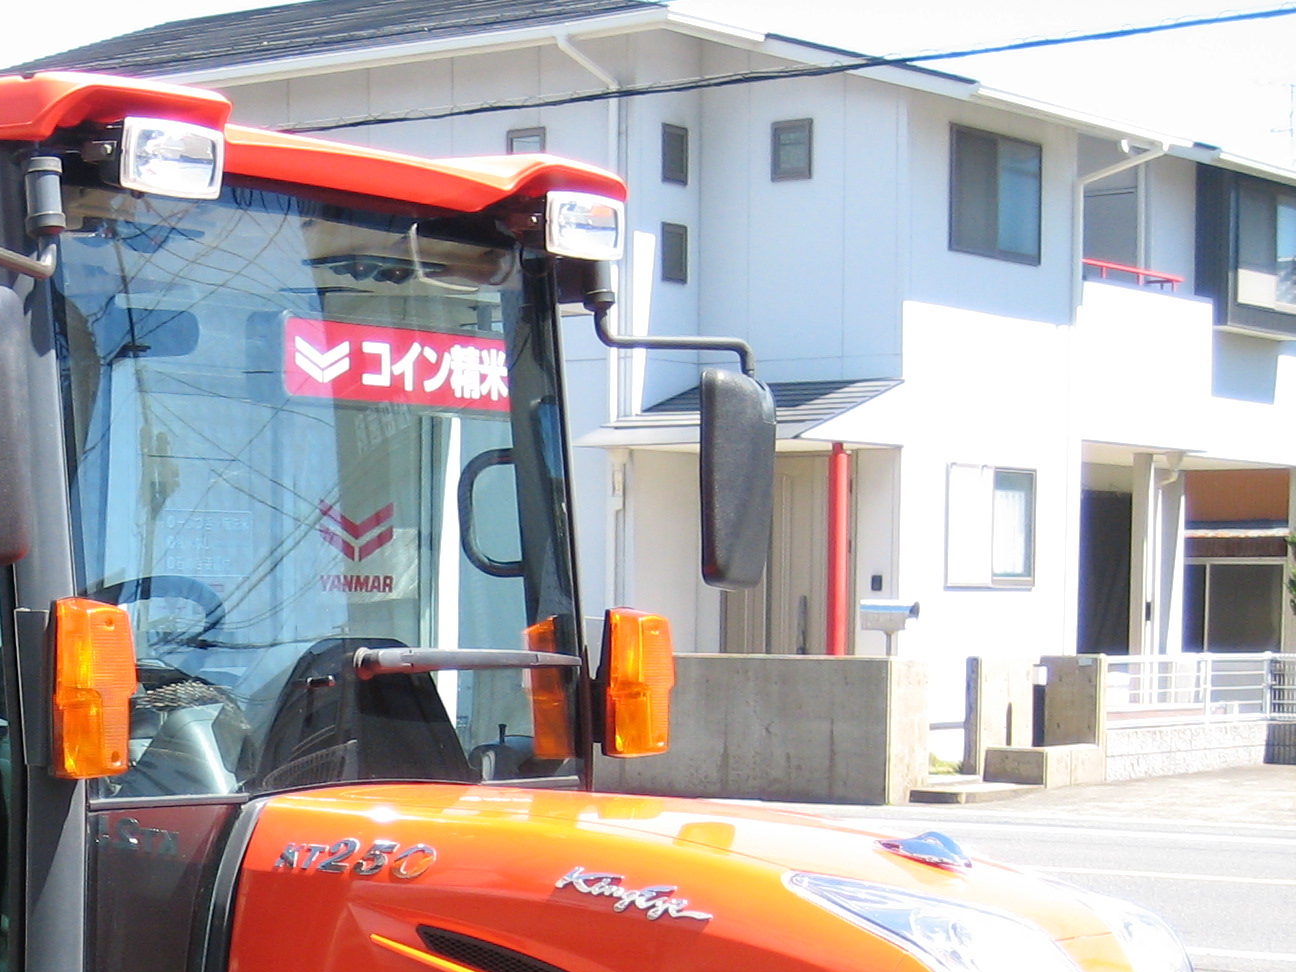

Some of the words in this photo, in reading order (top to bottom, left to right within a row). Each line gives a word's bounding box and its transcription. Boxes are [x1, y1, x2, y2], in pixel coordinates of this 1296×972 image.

[361, 340, 509, 401] コイン精米
[320, 574, 394, 593] YANMAR
[273, 837, 437, 879] KT250
